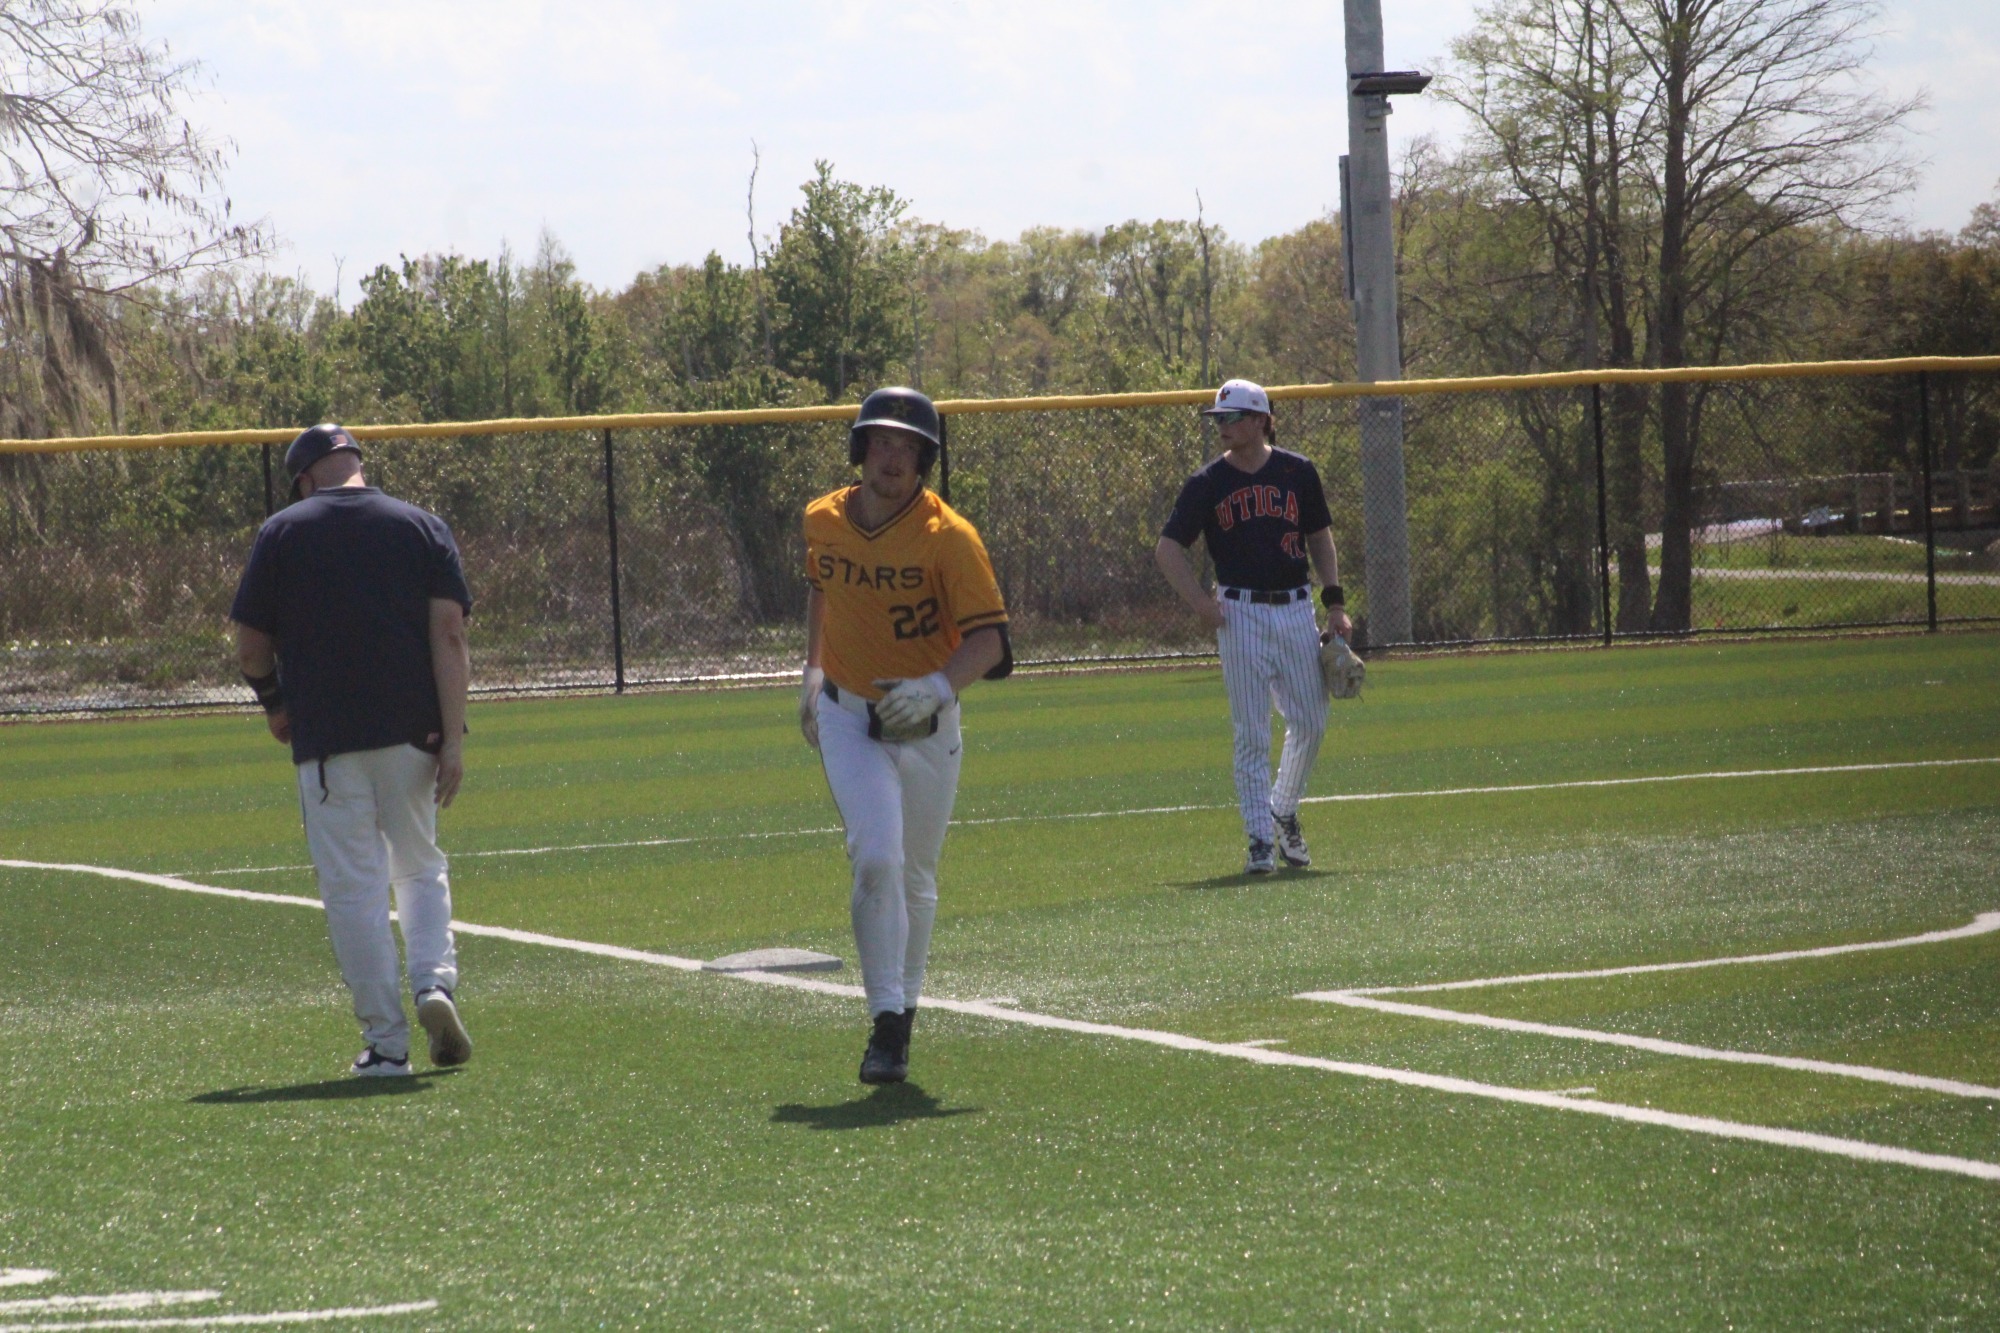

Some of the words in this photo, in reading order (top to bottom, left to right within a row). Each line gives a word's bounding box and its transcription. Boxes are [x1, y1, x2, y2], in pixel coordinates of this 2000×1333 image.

[1216, 485, 1299, 531] UTICA
[818, 555, 924, 591] STARS
[888, 597, 940, 641] 22
